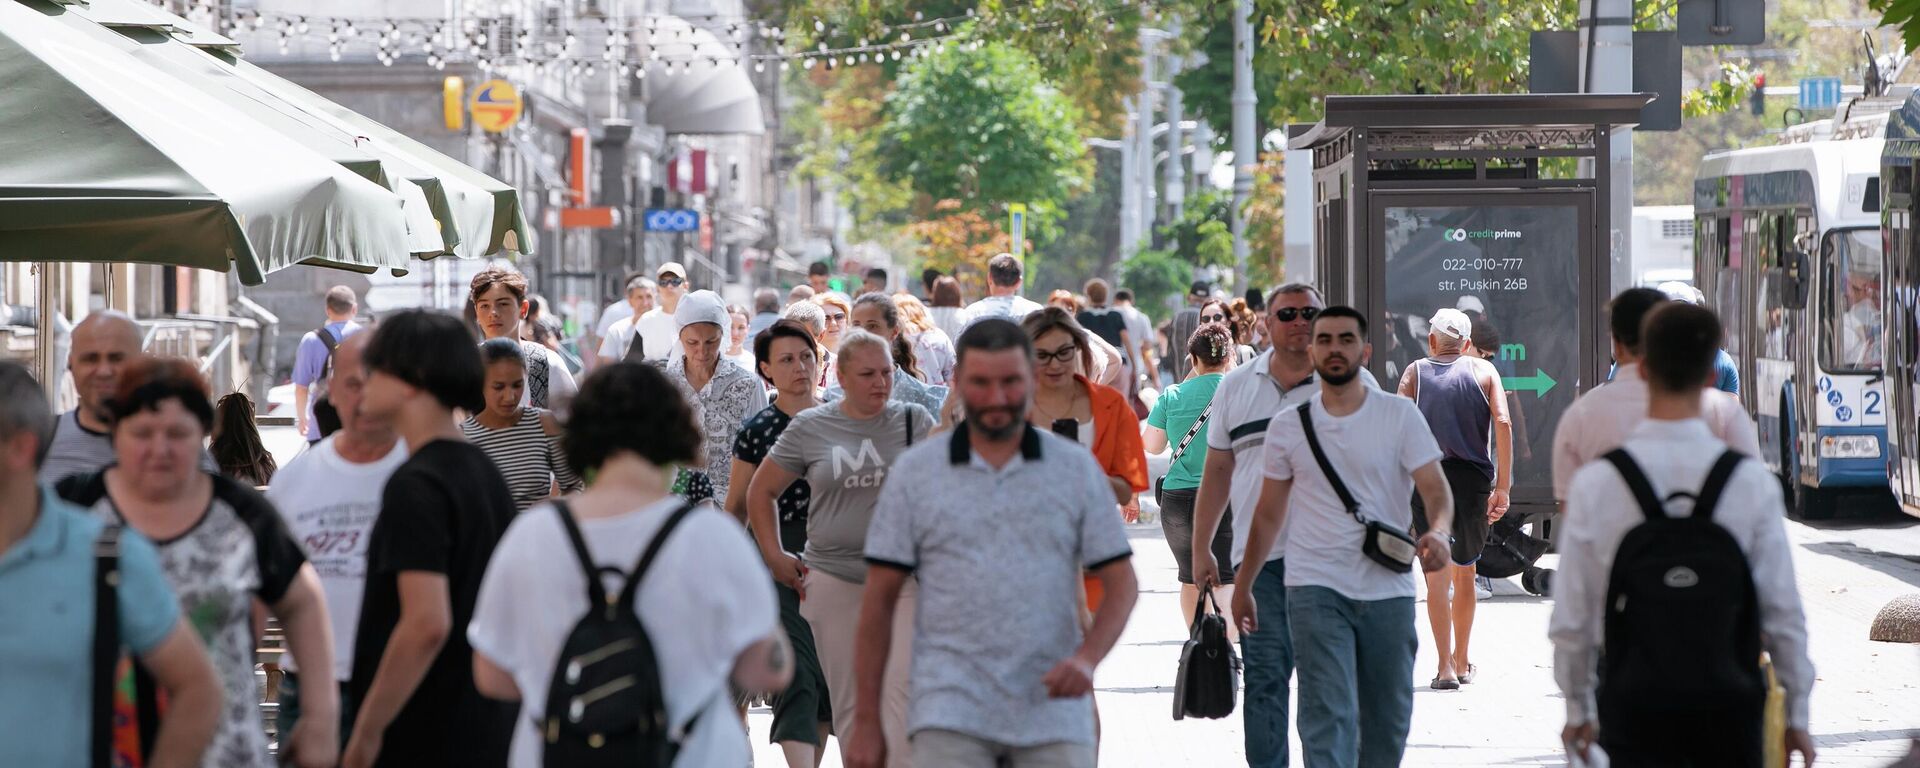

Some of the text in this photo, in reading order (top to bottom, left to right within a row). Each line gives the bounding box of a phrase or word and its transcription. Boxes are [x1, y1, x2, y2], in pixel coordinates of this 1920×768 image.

[1442, 258, 1523, 271] 022-010-777
[1438, 280, 1456, 291] str.
[1503, 278, 1528, 290] 26B
[1500, 343, 1526, 361] m
[1864, 390, 1881, 415] 2
[832, 438, 885, 480] M
